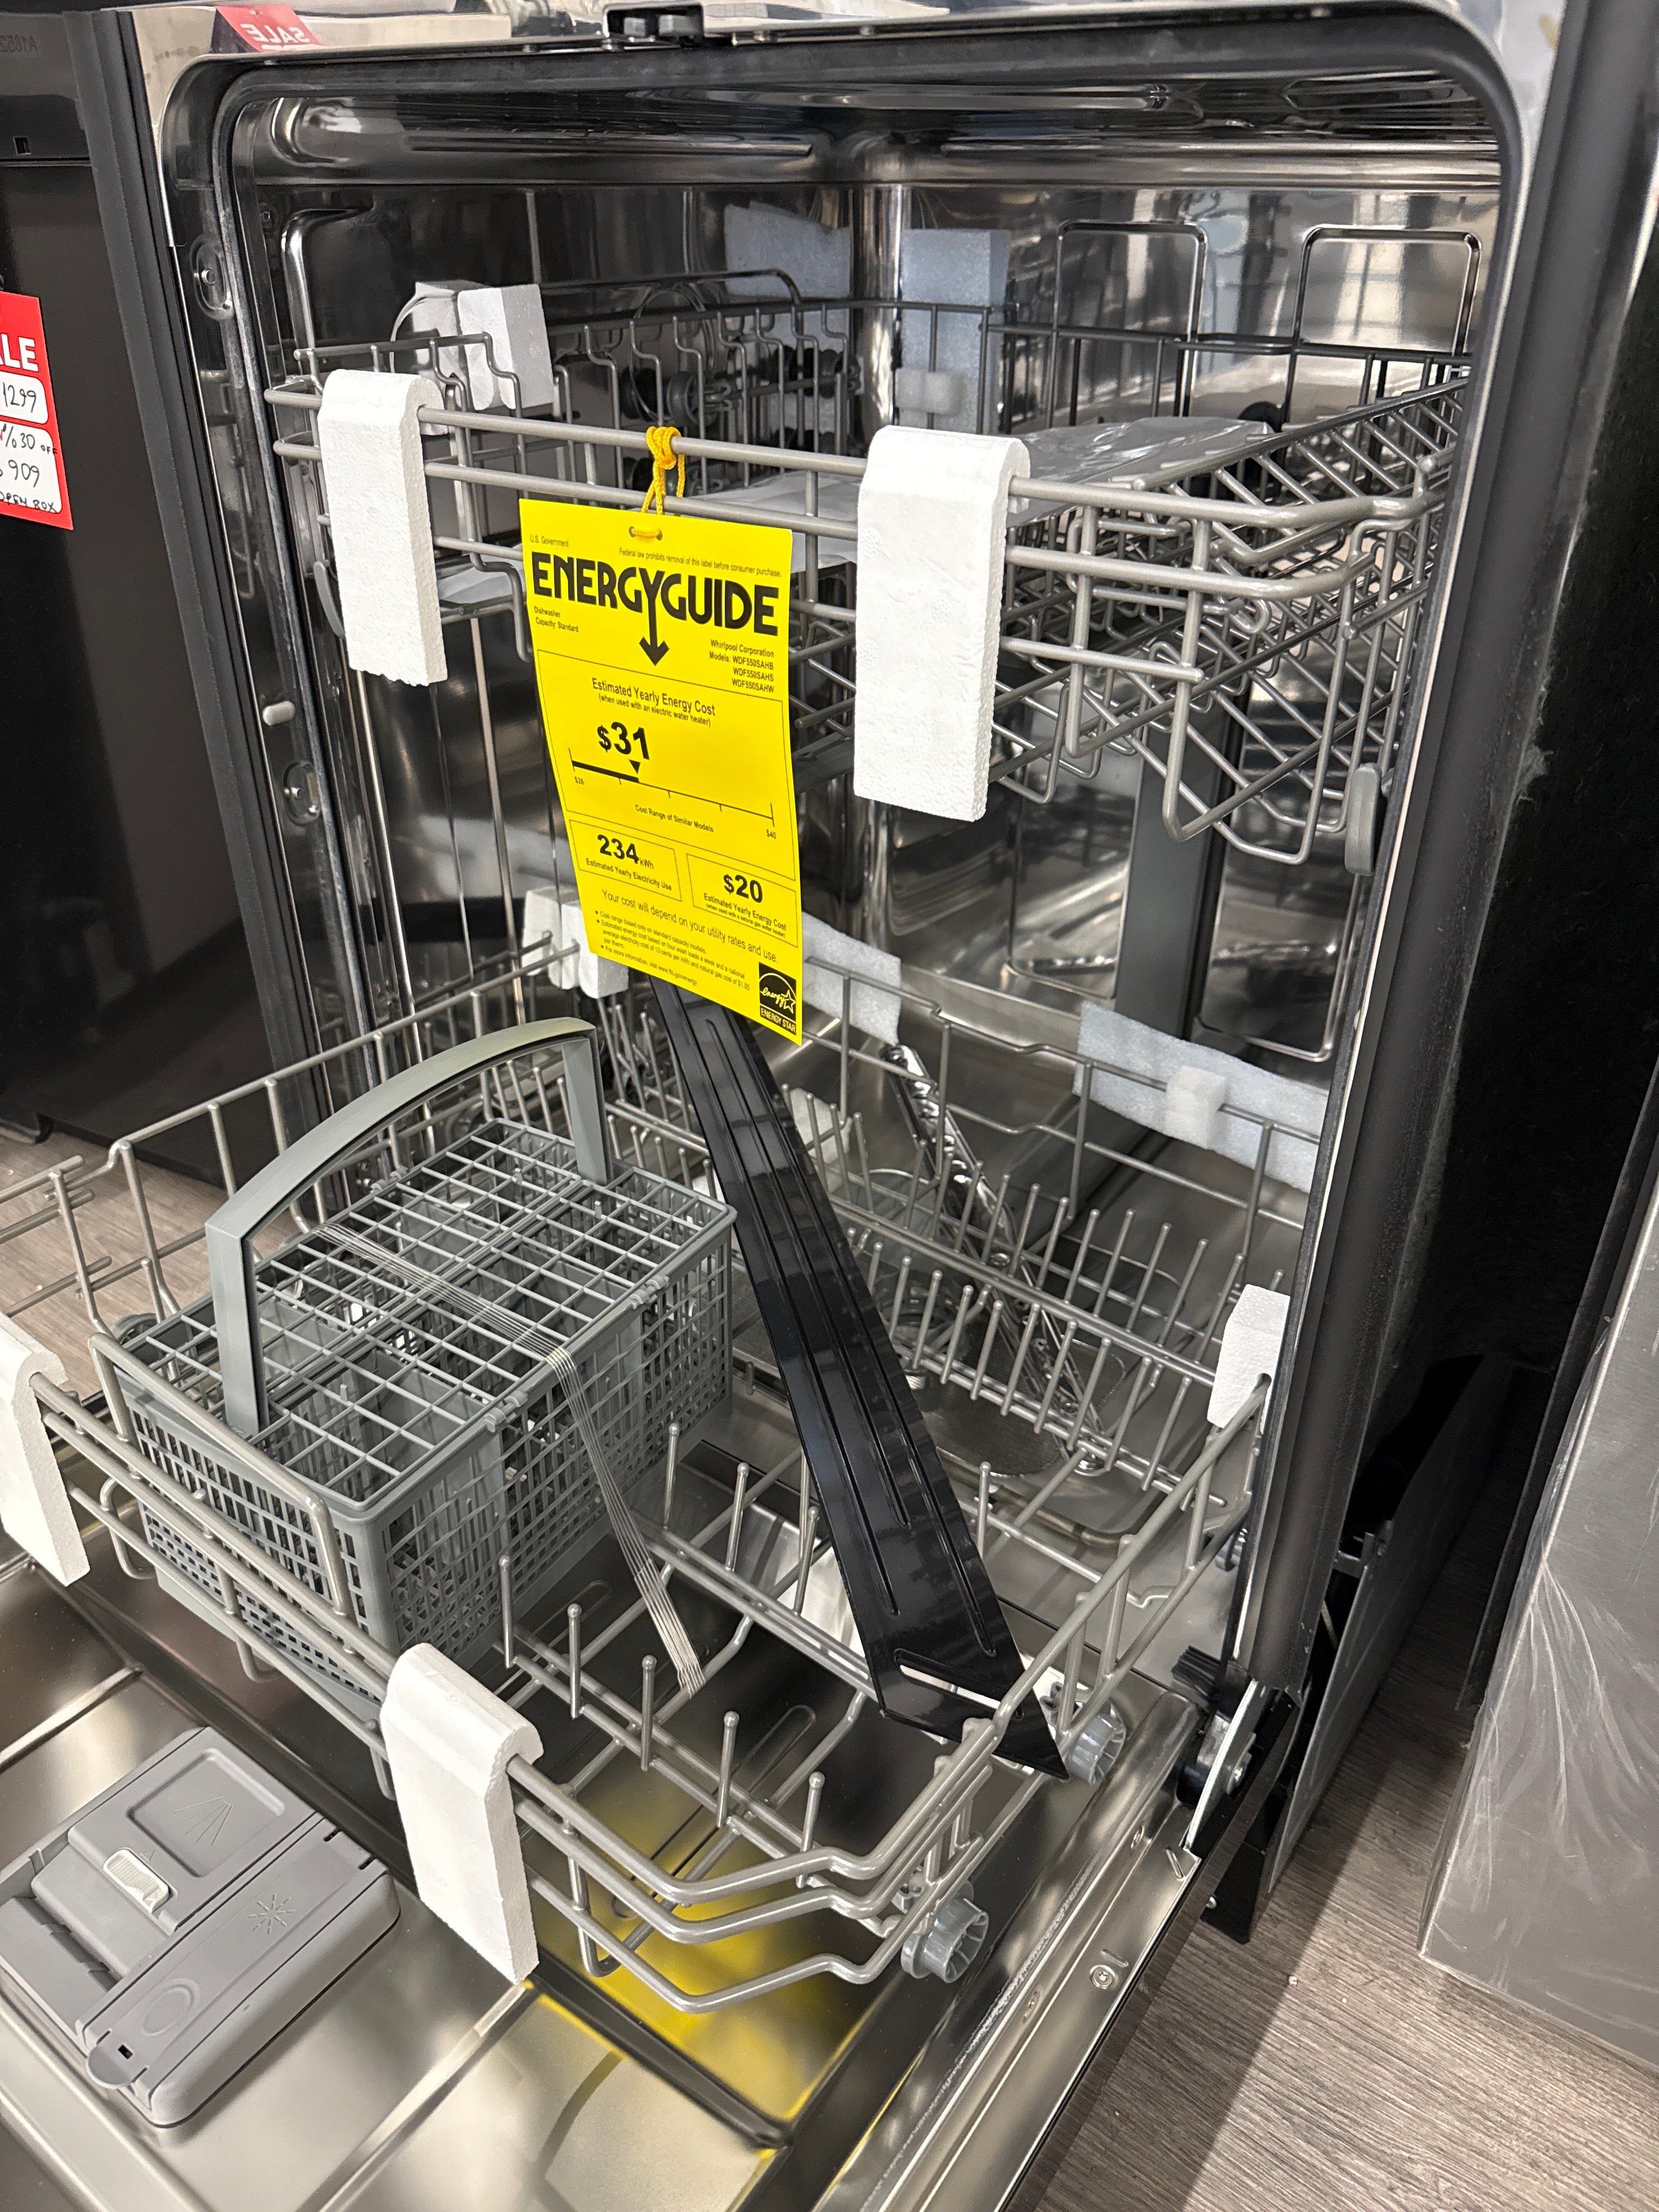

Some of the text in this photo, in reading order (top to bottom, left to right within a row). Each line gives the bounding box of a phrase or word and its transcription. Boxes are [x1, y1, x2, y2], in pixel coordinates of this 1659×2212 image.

[0, 333, 39, 373] LE
[530, 534, 569, 547] U.S. Government
[619, 548, 636, 557] Federal
[646, 551, 665, 561] prohibits
[666, 556, 684, 565] removal
[691, 558, 700, 566] this
[701, 559, 713, 568] label
[714, 561, 729, 571] before
[731, 564, 755, 574] consumer
[757, 568, 782, 578] purchase.
[531, 551, 779, 637] ENERGYGUIDE
[534, 606, 561, 618] Dishwasher
[557, 621, 579, 633] Standard
[709, 651, 774, 670] Models: WDF550SAHB
[710, 639, 774, 658] Whirlpool Corporation
[732, 678, 774, 693] WDF550SAHW
[733, 667, 774, 682] WDF550SAHS
[592, 677, 715, 716] Estimated Yearly Energy Cost
[599, 692, 615, 703] (when
[616, 698, 629, 707] used
[630, 701, 642, 710] with
[651, 706, 672, 717] electric
[673, 712, 689, 721] water
[690, 714, 711, 728] heater)
[597, 721, 650, 760] $31
[635, 804, 714, 833] Cost Range of Similar Models
[766, 829, 777, 839] $40
[597, 834, 654, 870] 234 kWh
[585, 857, 672, 891] Estimated Yearly Electricity Use
[723, 873, 763, 903] $20
[601, 889, 778, 964] Your cost will depend on your utility rates and use.
[704, 893, 787, 932] Estimated Yearly Energy Cost
[611, 916, 623, 924] range
[624, 918, 636, 928] based
[637, 924, 646, 932] only
[653, 929, 672, 940] standard
[672, 936, 689, 948] capacity
[601, 919, 622, 931] Estimated
[623, 928, 637, 938] energy
[647, 935, 660, 945] based
[729, 968, 744, 979] national
[620, 935, 640, 947] electricity
[699, 965, 714, 975] natural
[761, 1008, 795, 1033] ENERGY STAR
